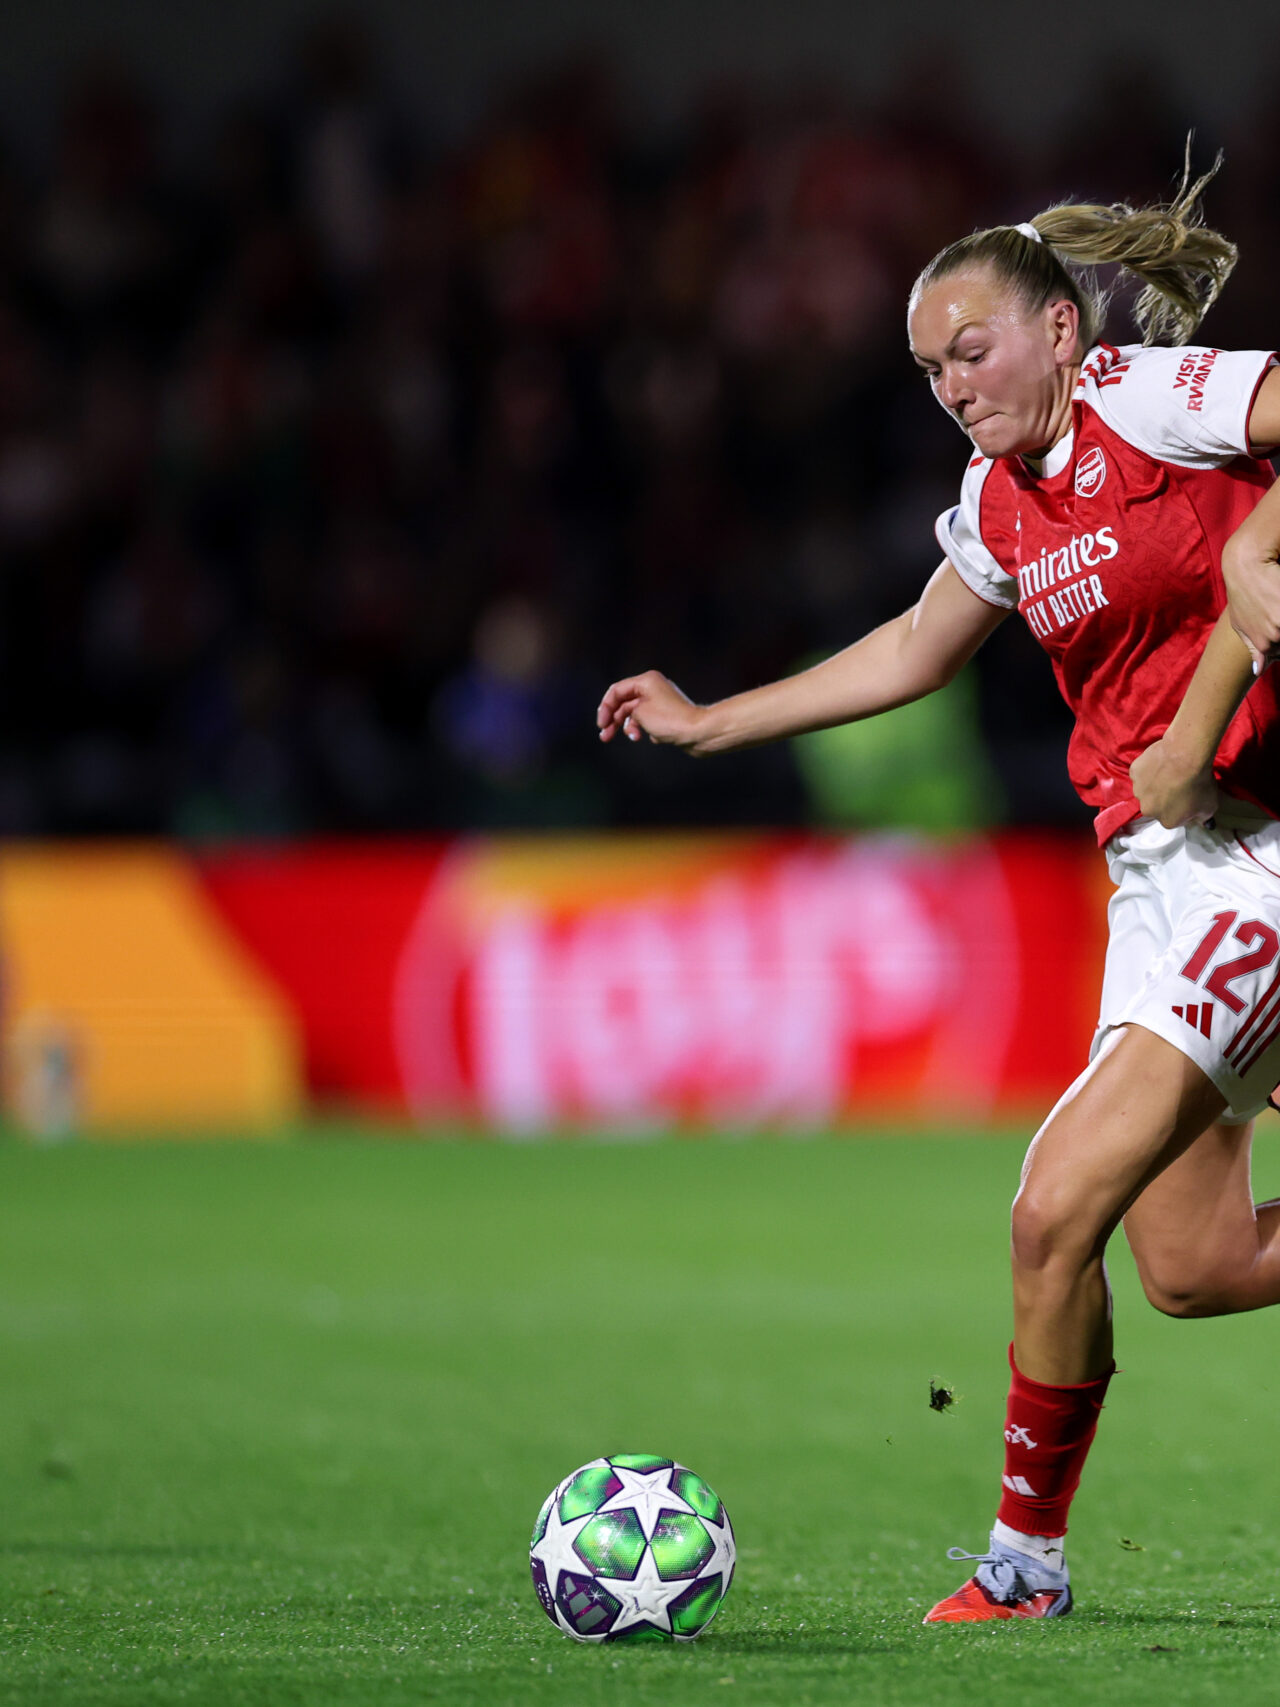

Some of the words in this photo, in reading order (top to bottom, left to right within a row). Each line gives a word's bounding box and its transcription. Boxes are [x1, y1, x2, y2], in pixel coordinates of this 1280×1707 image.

[1173, 353, 1199, 389] VISIT
[1017, 526, 1119, 603] mirates
[1026, 600, 1054, 639] FLY
[1047, 574, 1110, 628] BETTER
